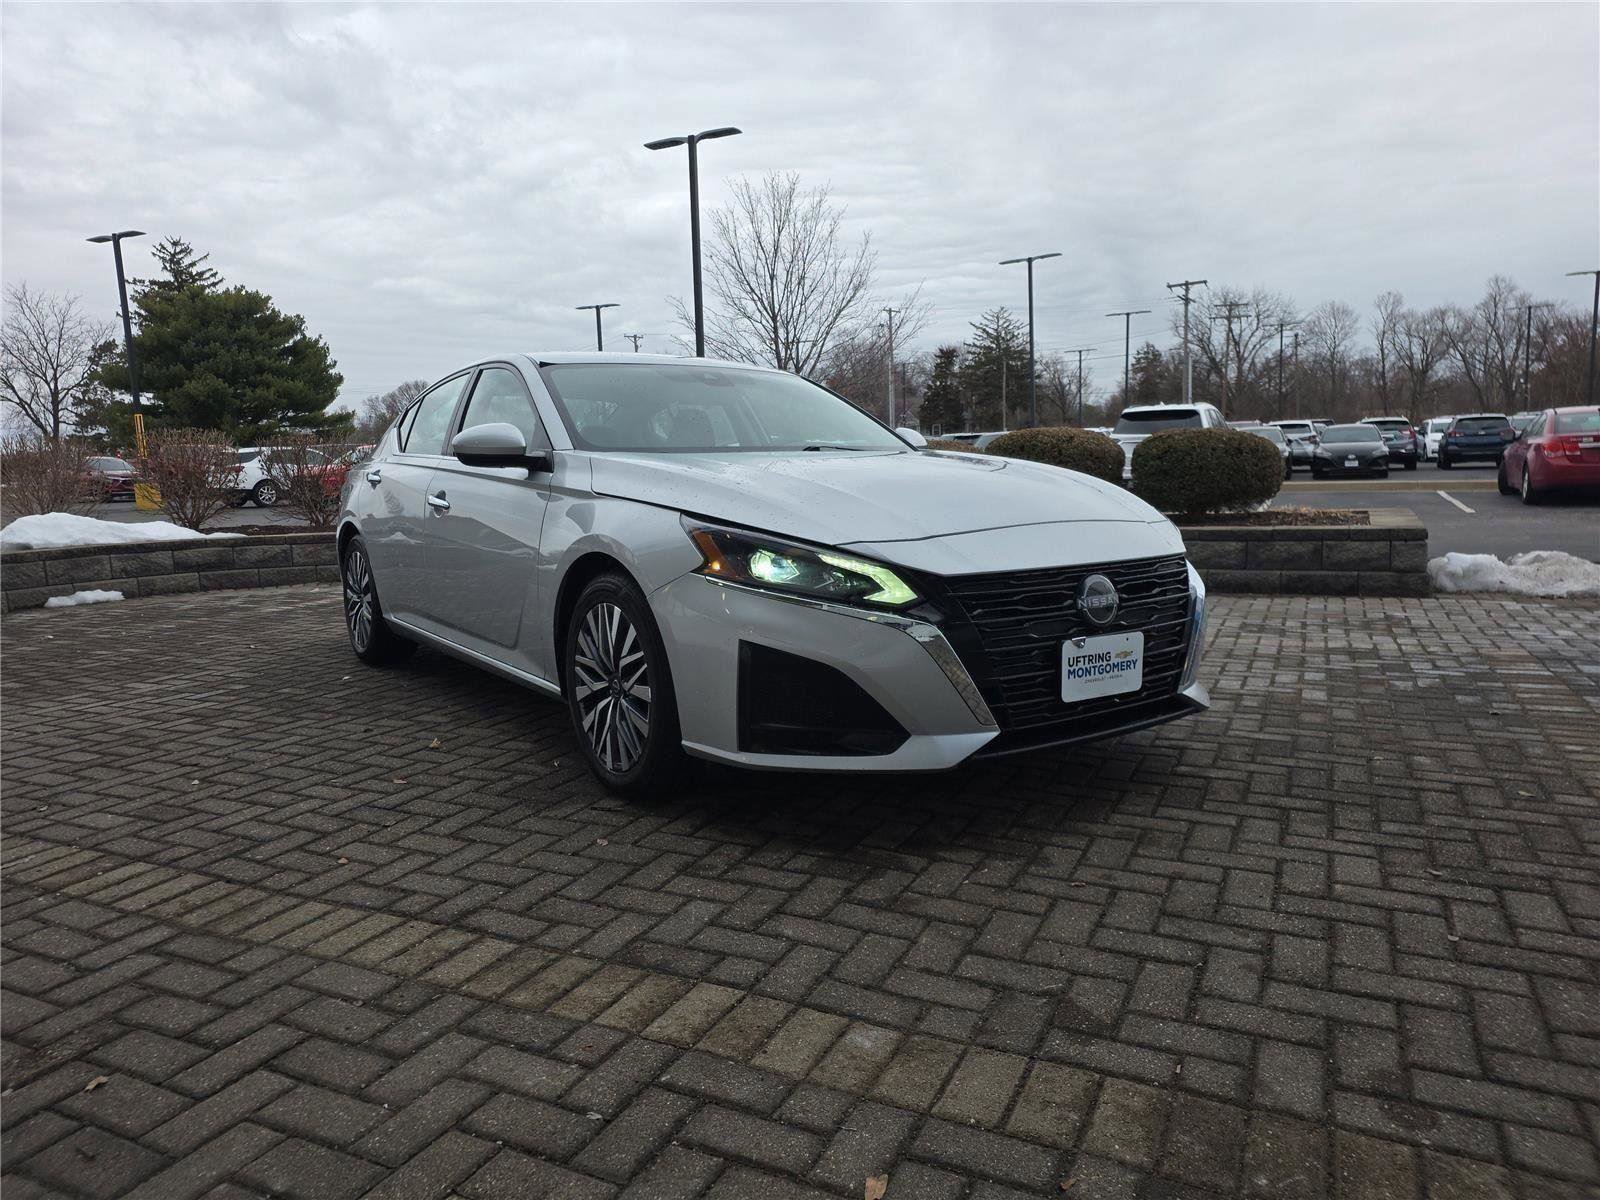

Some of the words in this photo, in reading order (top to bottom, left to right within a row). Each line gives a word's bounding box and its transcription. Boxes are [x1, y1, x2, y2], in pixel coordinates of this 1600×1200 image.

[1077, 594, 1120, 609] NISSAN
[1068, 651, 1112, 668] UFTRING
[1067, 659, 1138, 680] MONTGOMERY
